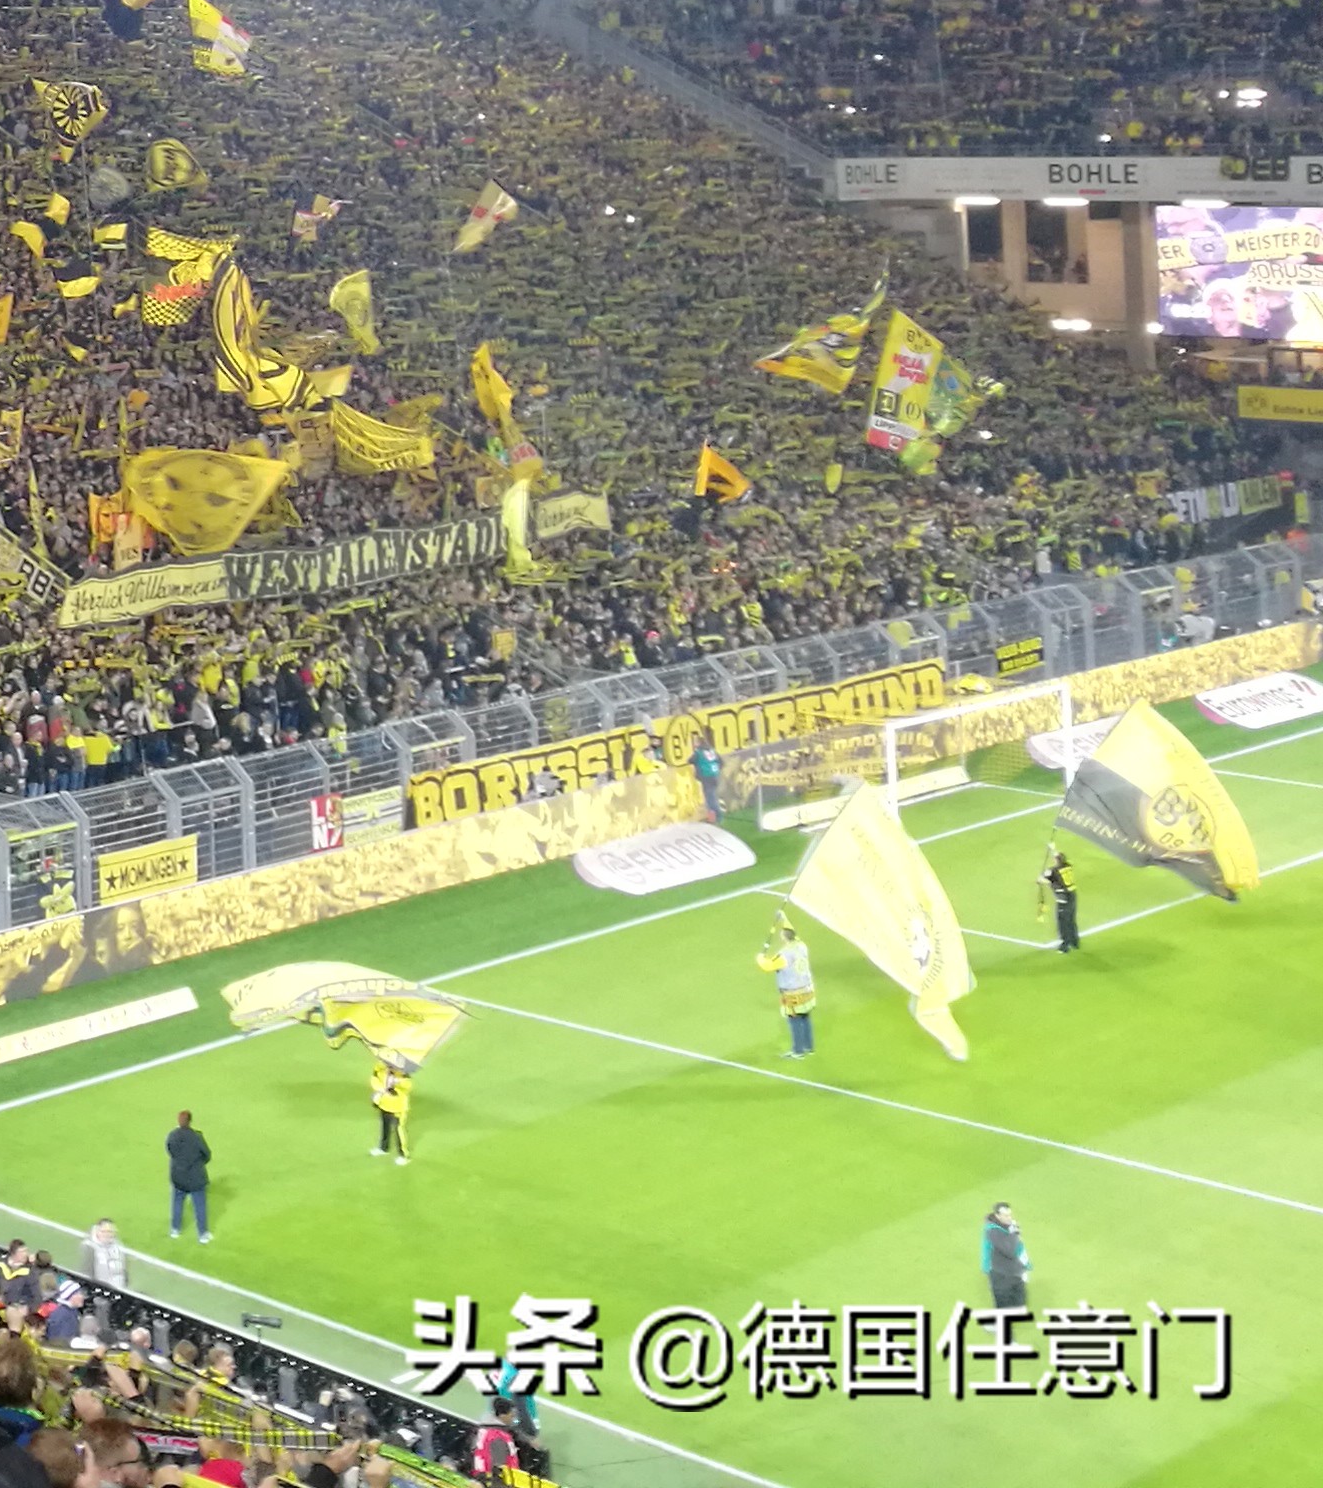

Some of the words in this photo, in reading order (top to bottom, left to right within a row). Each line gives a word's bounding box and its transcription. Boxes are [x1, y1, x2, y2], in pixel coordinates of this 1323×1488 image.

[844, 164, 899, 184] BOHLE
[1047, 162, 1140, 185] BOHLE
[1235, 232, 1301, 253] MEISTER
[706, 663, 946, 755] DORTMUND
